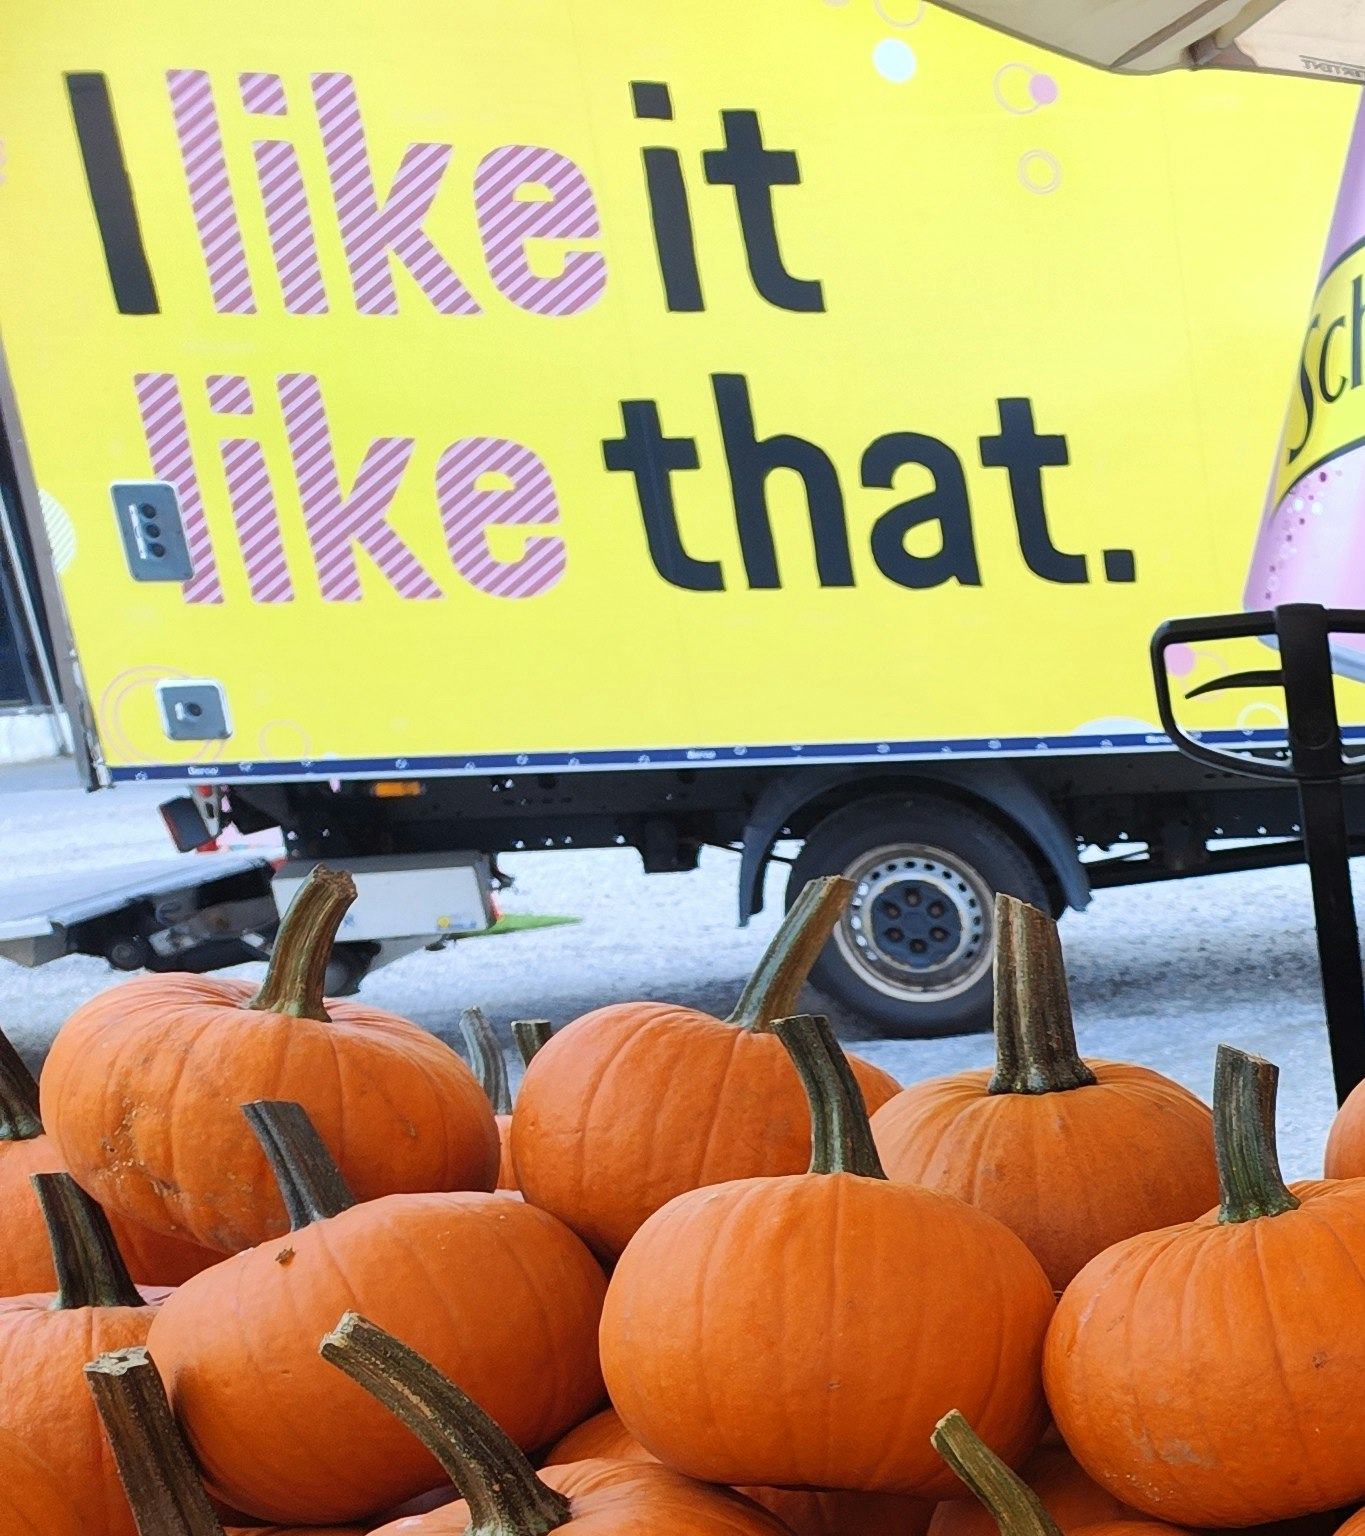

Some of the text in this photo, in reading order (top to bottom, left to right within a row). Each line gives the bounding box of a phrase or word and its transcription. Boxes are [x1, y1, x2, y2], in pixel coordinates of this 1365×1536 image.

[64, 69, 827, 316] I like it
[133, 371, 1137, 604] like that.
